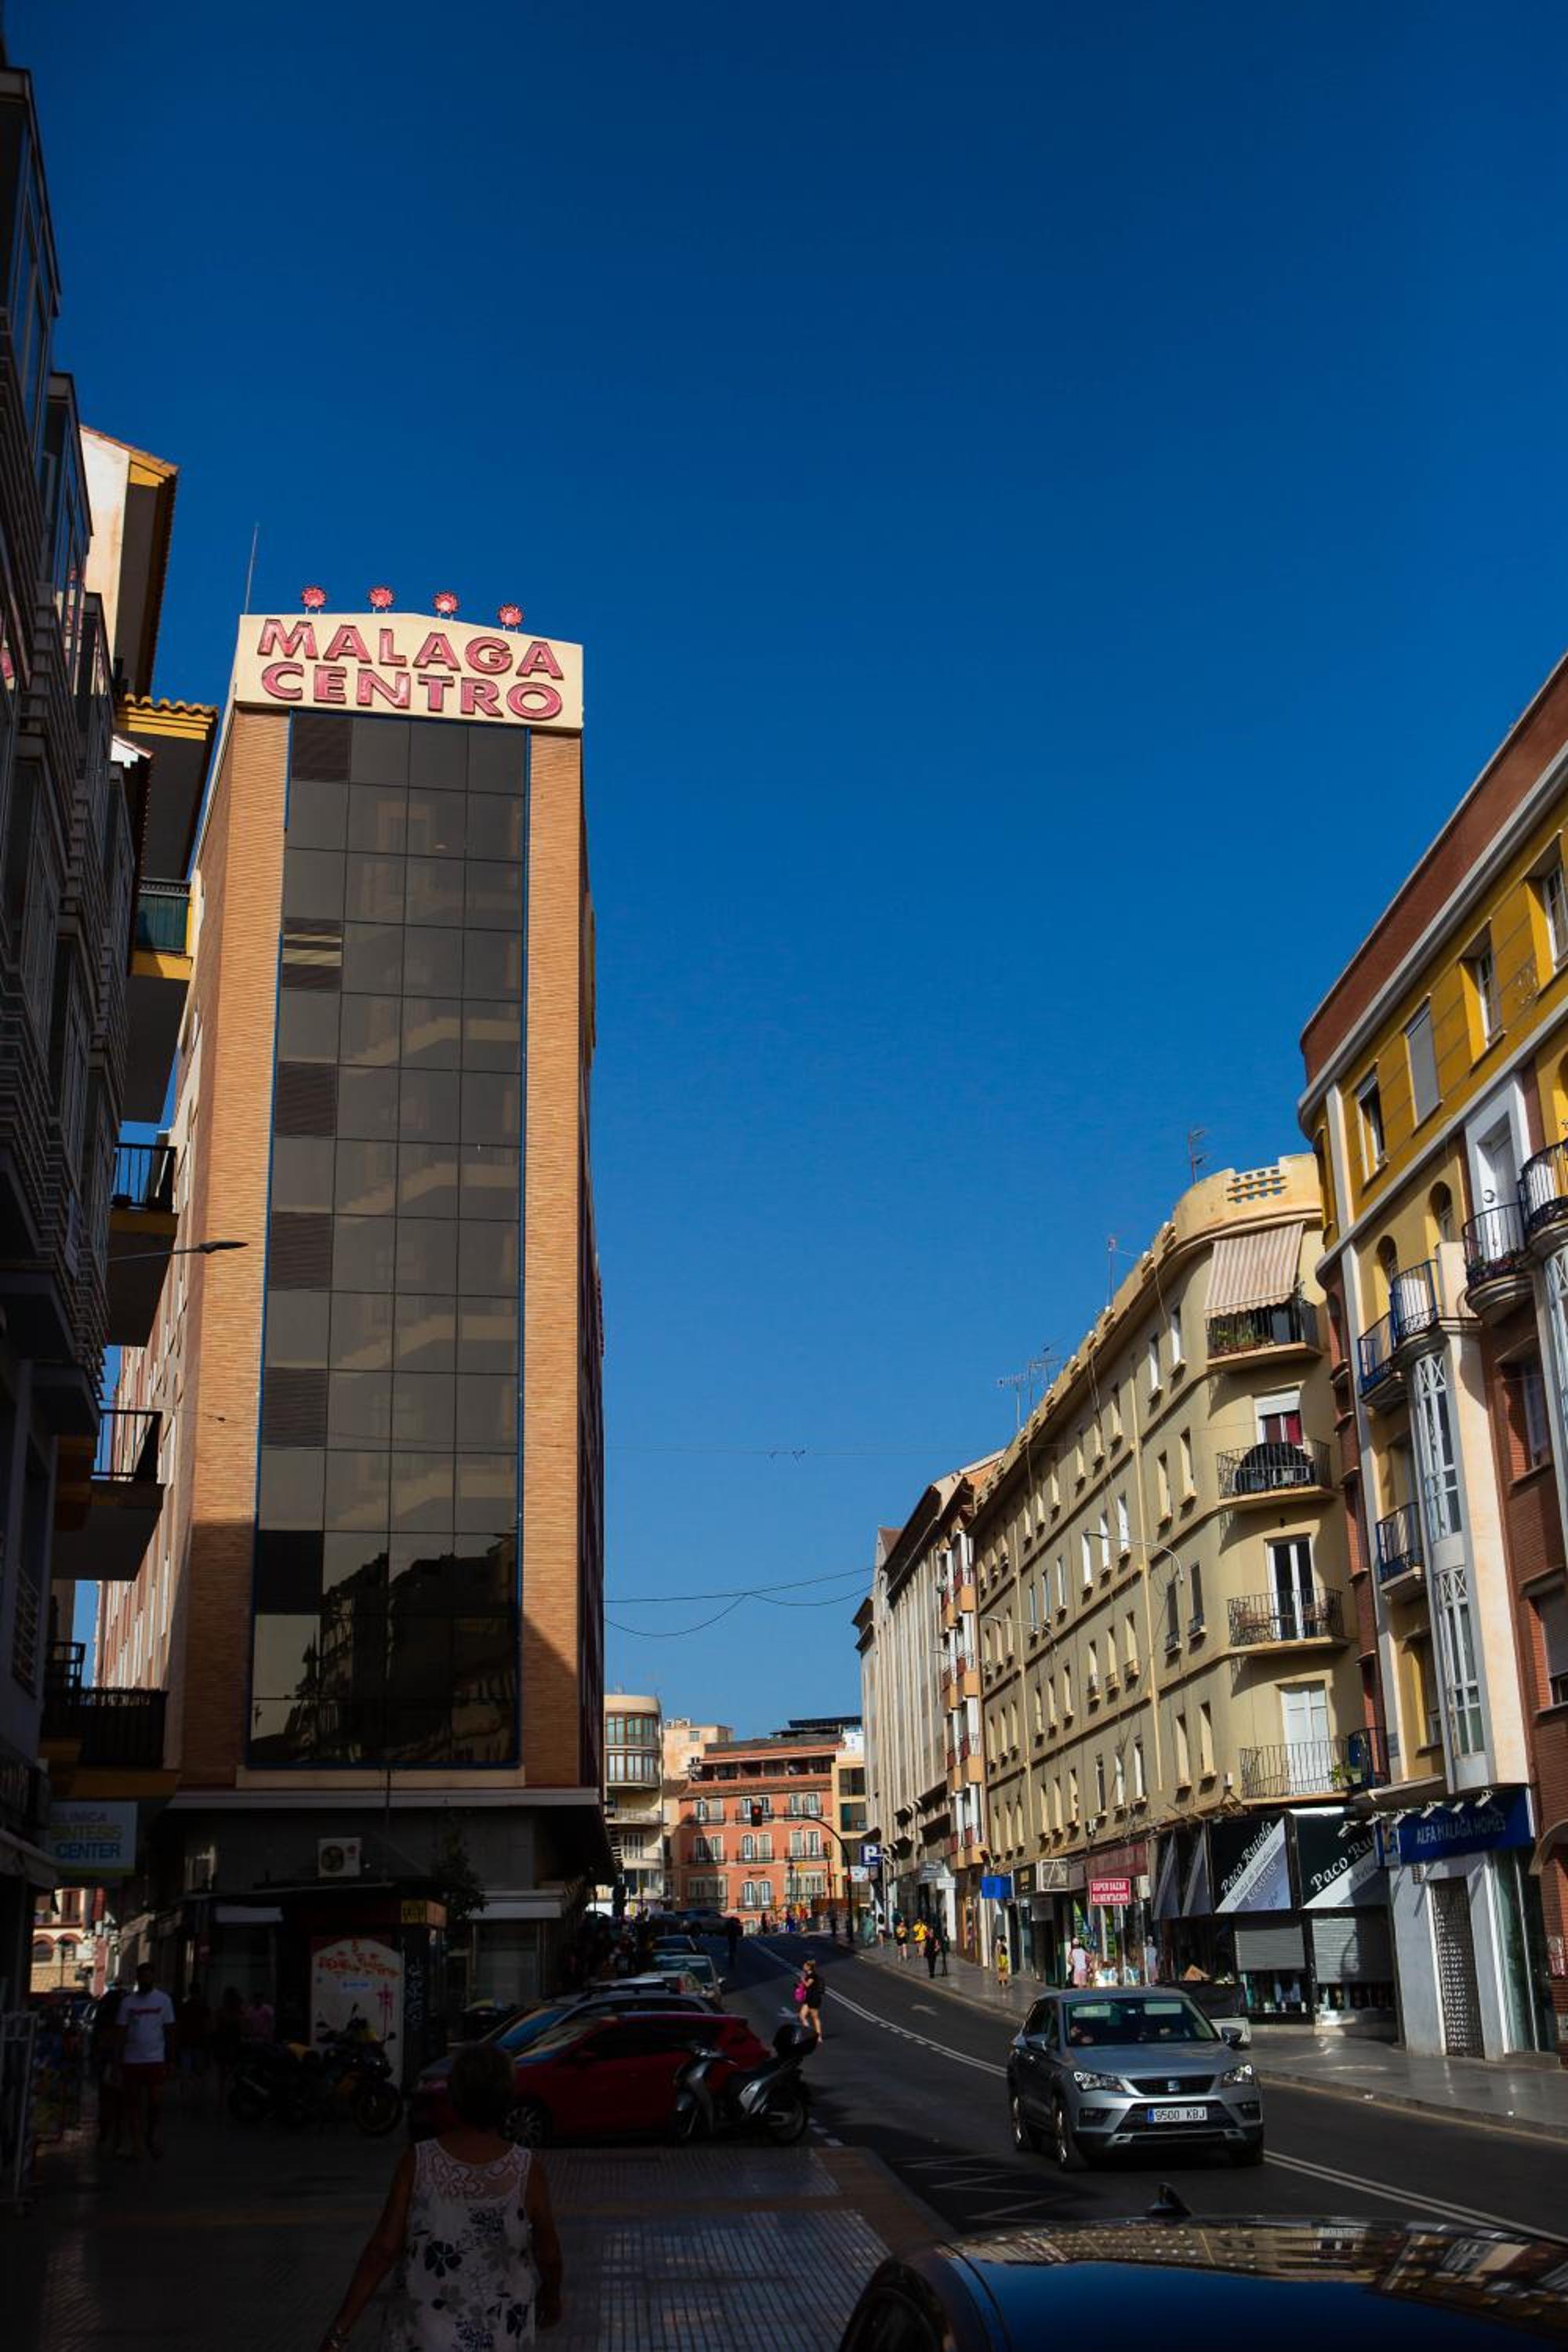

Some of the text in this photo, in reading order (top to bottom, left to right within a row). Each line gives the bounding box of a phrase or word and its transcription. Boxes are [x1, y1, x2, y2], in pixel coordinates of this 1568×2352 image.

[257, 619, 564, 680] MALAGA
[261, 661, 562, 720] CENTRO
[55, 1843, 120, 1857] CENTER
[864, 1845, 877, 1861] P
[1221, 1863, 1243, 1894] Paco
[1311, 1857, 1348, 1891] Paco
[1155, 2110, 1180, 2121] 9500
